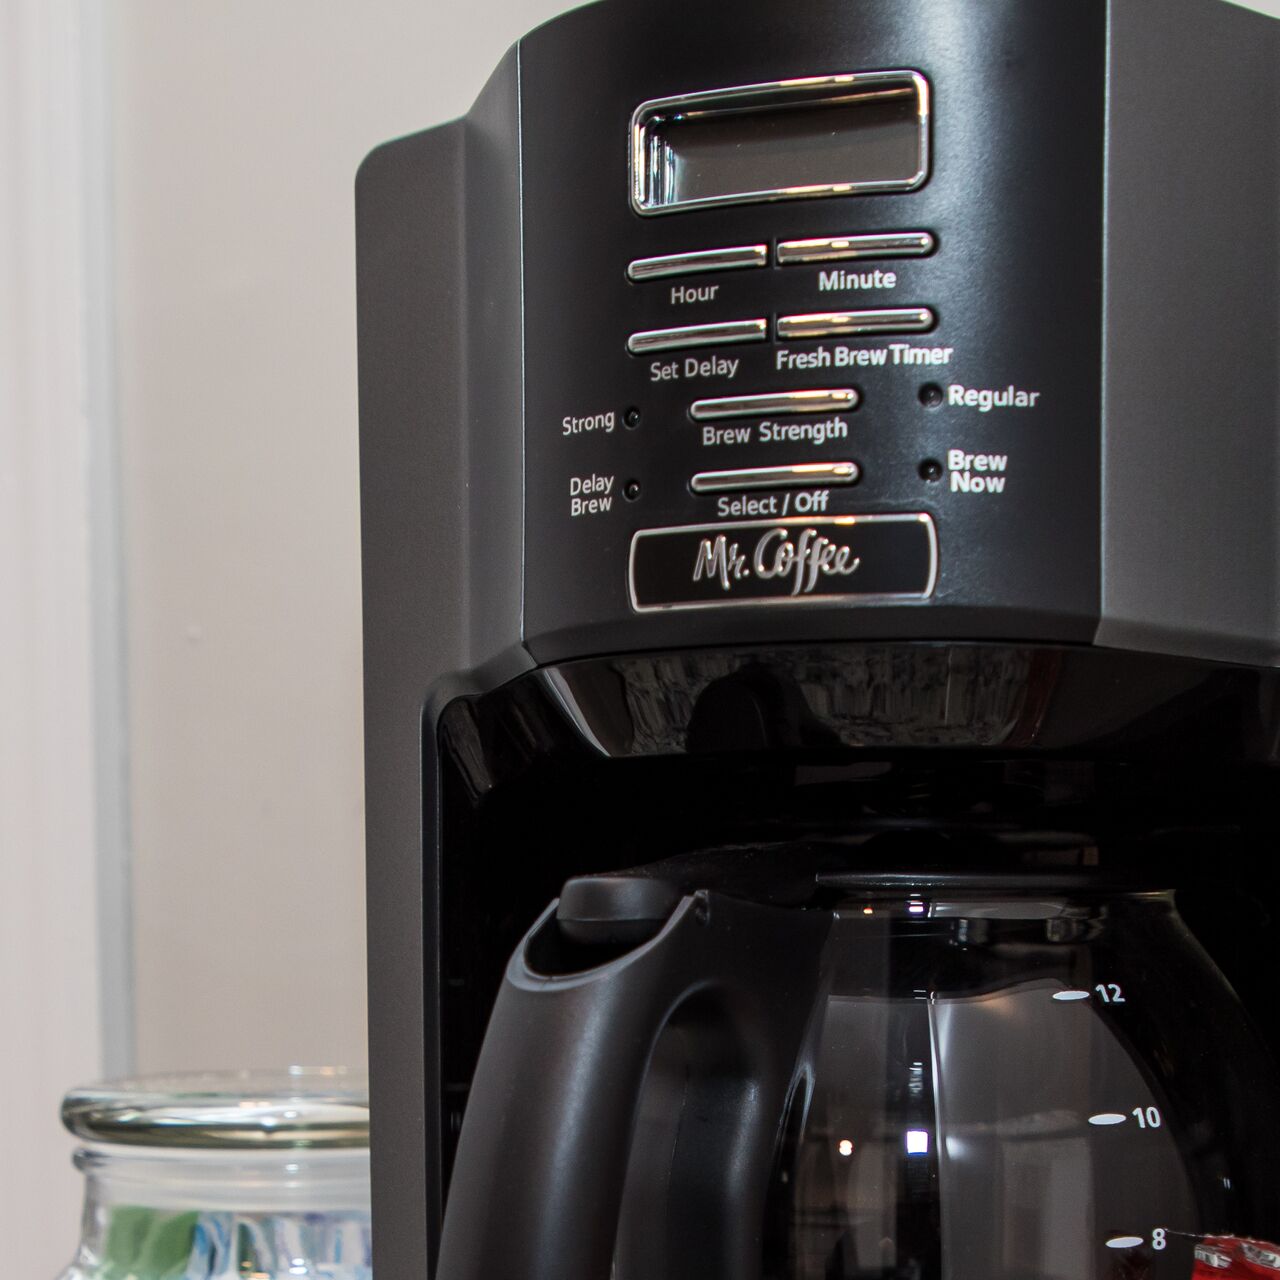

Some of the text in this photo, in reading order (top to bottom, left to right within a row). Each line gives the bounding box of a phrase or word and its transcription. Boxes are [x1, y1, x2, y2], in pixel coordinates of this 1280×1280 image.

[819, 270, 897, 291] Minute
[670, 283, 719, 304] Hour
[776, 344, 952, 370] Fresh Brew Timer
[650, 356, 740, 382] Set Delay
[948, 385, 1040, 409] Regular
[562, 411, 615, 435] Strong
[702, 418, 848, 446] Brew Strength
[948, 450, 1008, 471] Brew
[570, 475, 615, 499] Delay
[950, 472, 1006, 494] Now
[570, 495, 613, 516] Brew
[717, 497, 777, 517] Select
[795, 491, 829, 512] Off
[693, 528, 860, 596] Mr. Coffee
[1095, 983, 1126, 1003] 12
[1132, 1106, 1161, 1129] 10
[1151, 1228, 1167, 1250] 8
